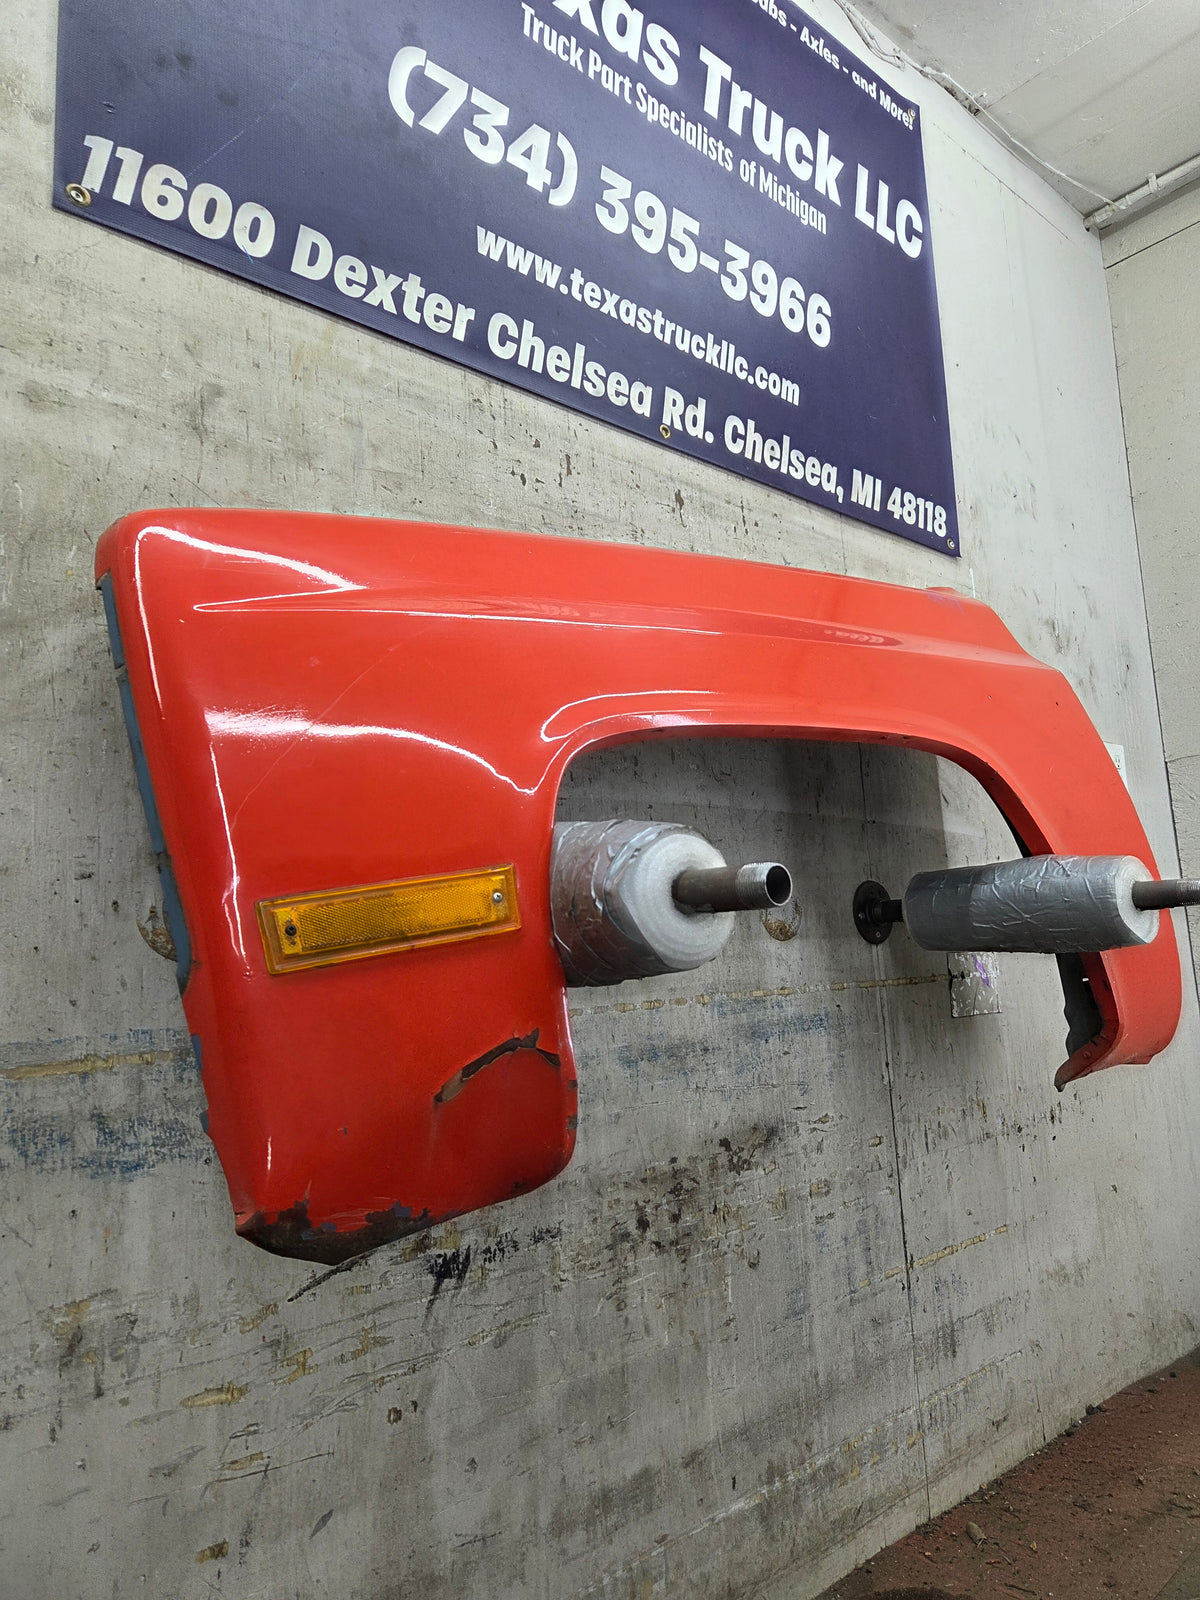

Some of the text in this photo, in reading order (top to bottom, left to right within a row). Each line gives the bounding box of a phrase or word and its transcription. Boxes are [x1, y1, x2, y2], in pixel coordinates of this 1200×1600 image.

[521, 2, 827, 236] Truck Part Specialists of Michigan
[699, 44, 845, 208] Truck
[854, 163, 924, 259] LLC
[751, 0, 787, 27] abs
[800, 26, 840, 70] Axles
[851, 70, 877, 100] and
[388, 46, 833, 348] (734) 395-3966
[81, 135, 947, 538] 11600 Dexter Chelsea Rd. Chelsea, MI 48118
[476, 224, 800, 407] www.texastruckllc.com
